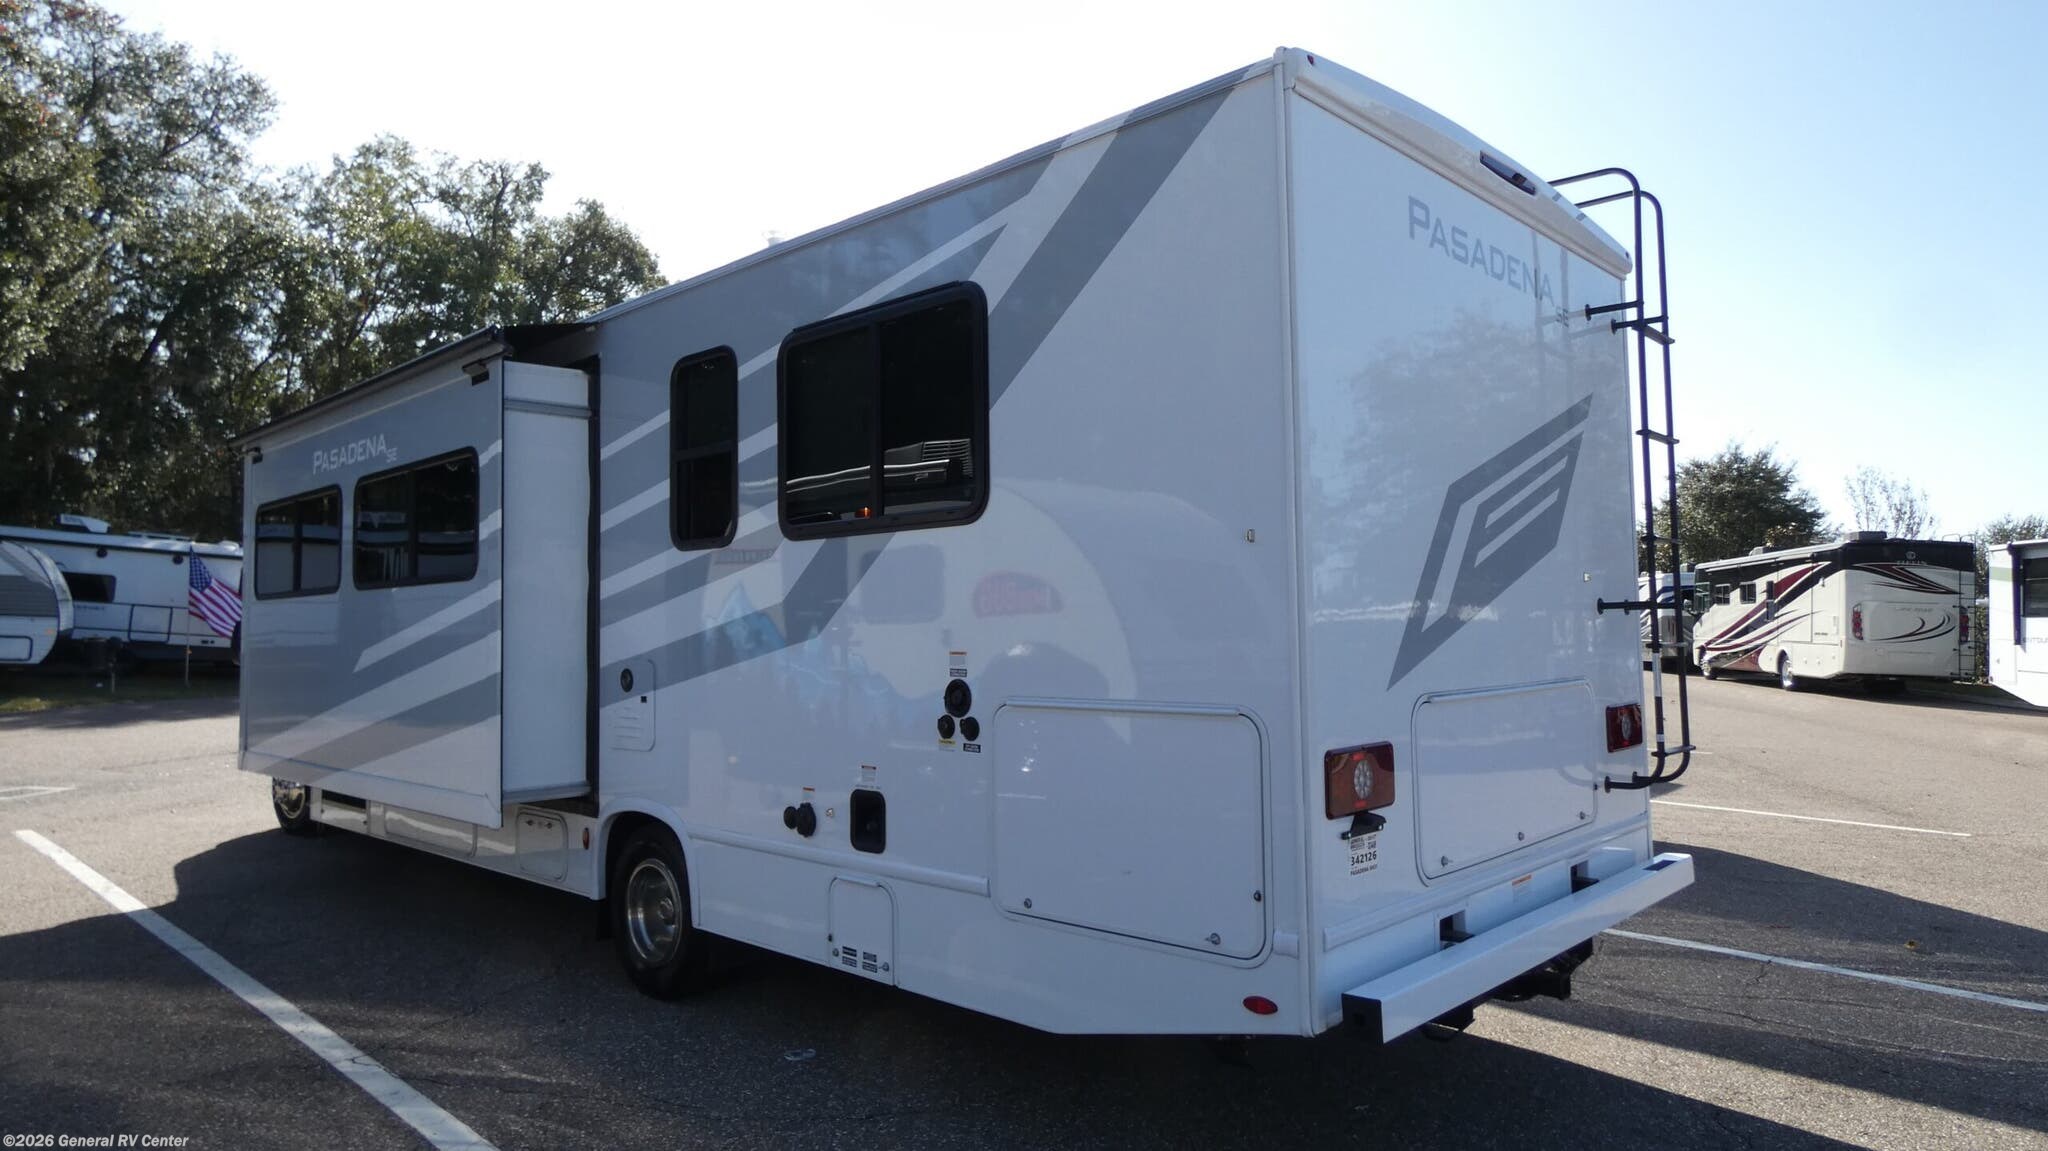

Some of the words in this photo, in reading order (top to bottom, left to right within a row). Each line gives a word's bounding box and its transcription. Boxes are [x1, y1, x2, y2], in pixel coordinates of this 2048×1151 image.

[1408, 195, 1555, 308] PASADENA
[1556, 306, 1569, 328] SE
[313, 433, 386, 475] PASADENA
[386, 447, 398, 463] SE
[1351, 850, 1377, 866] 342126
